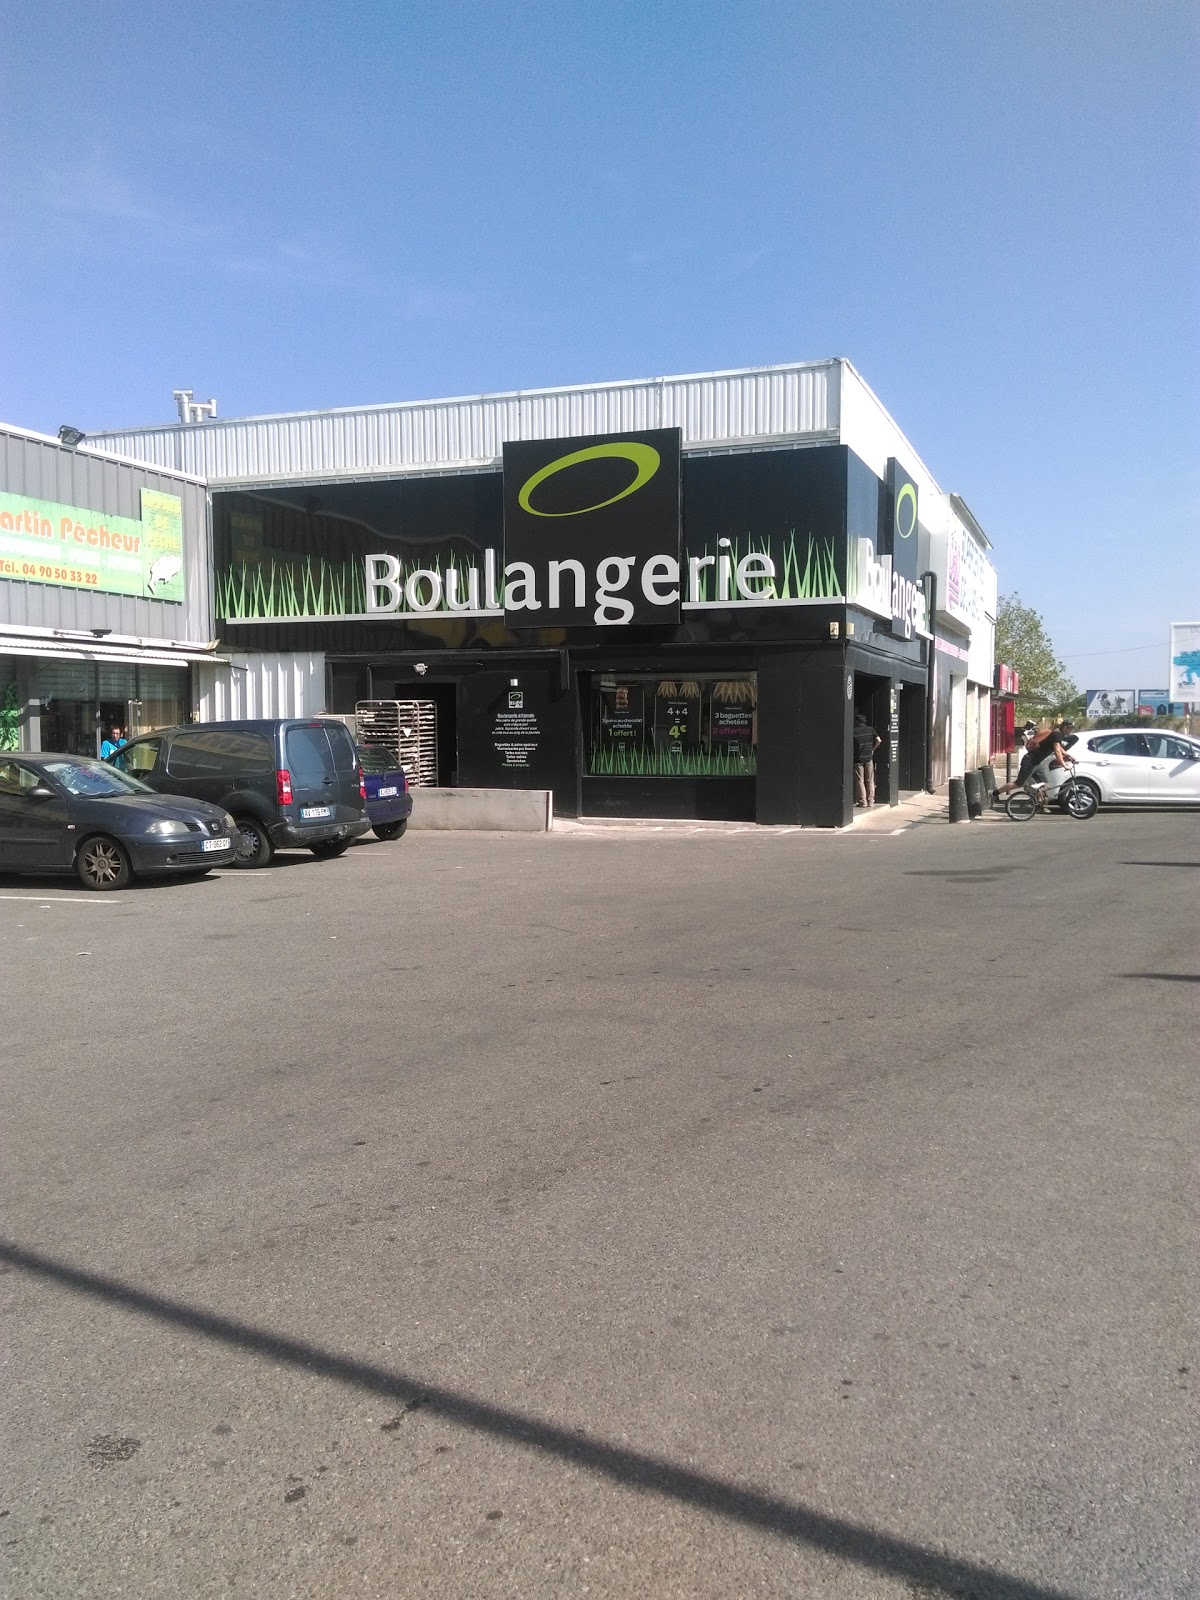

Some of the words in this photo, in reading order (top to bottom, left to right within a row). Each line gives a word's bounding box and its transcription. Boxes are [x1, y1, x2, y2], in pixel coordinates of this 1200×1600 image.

[60, 516, 141, 553] Pêcheur
[0, 559, 19, 574] Tél.
[22, 563, 36, 576] 04
[39, 565, 52, 578] 90
[54, 567, 68, 581] 50
[70, 570, 83, 583] 33
[85, 572, 98, 585] 22
[365, 536, 778, 626] Boulangerie
[667, 707, 674, 716] 4
[681, 707, 689, 716] 4
[720, 712, 752, 720] baguettes
[608, 728, 612, 736] 1
[719, 727, 751, 735] offertes
